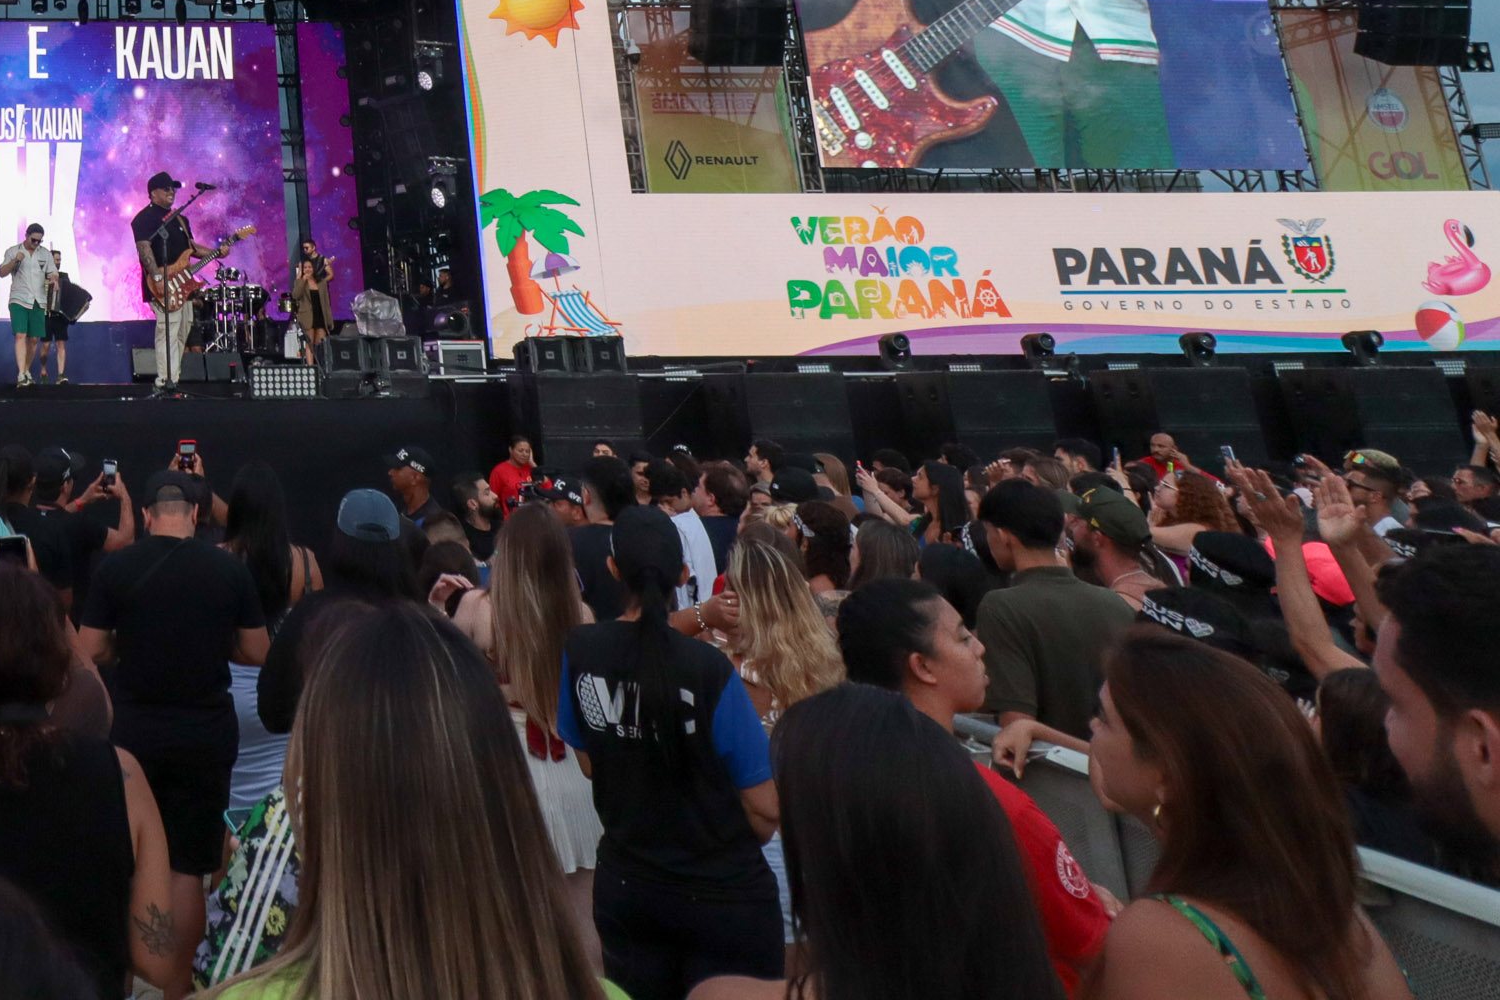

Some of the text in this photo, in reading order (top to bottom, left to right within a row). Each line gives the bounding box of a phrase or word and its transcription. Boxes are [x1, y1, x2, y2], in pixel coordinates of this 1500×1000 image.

[29, 26, 48, 79] E
[115, 26, 234, 81] KAUAN
[32, 107, 82, 140] KAUAN
[695, 156, 759, 165] RENAULT
[1368, 151, 1440, 180] GOL
[790, 205, 925, 245] VERÃO
[822, 245, 959, 278] MAIOR
[1052, 239, 1284, 285] PARANÁ
[786, 269, 1013, 319] PARANÁ
[1063, 298, 1353, 312] GOVERNO DO ESTADO
